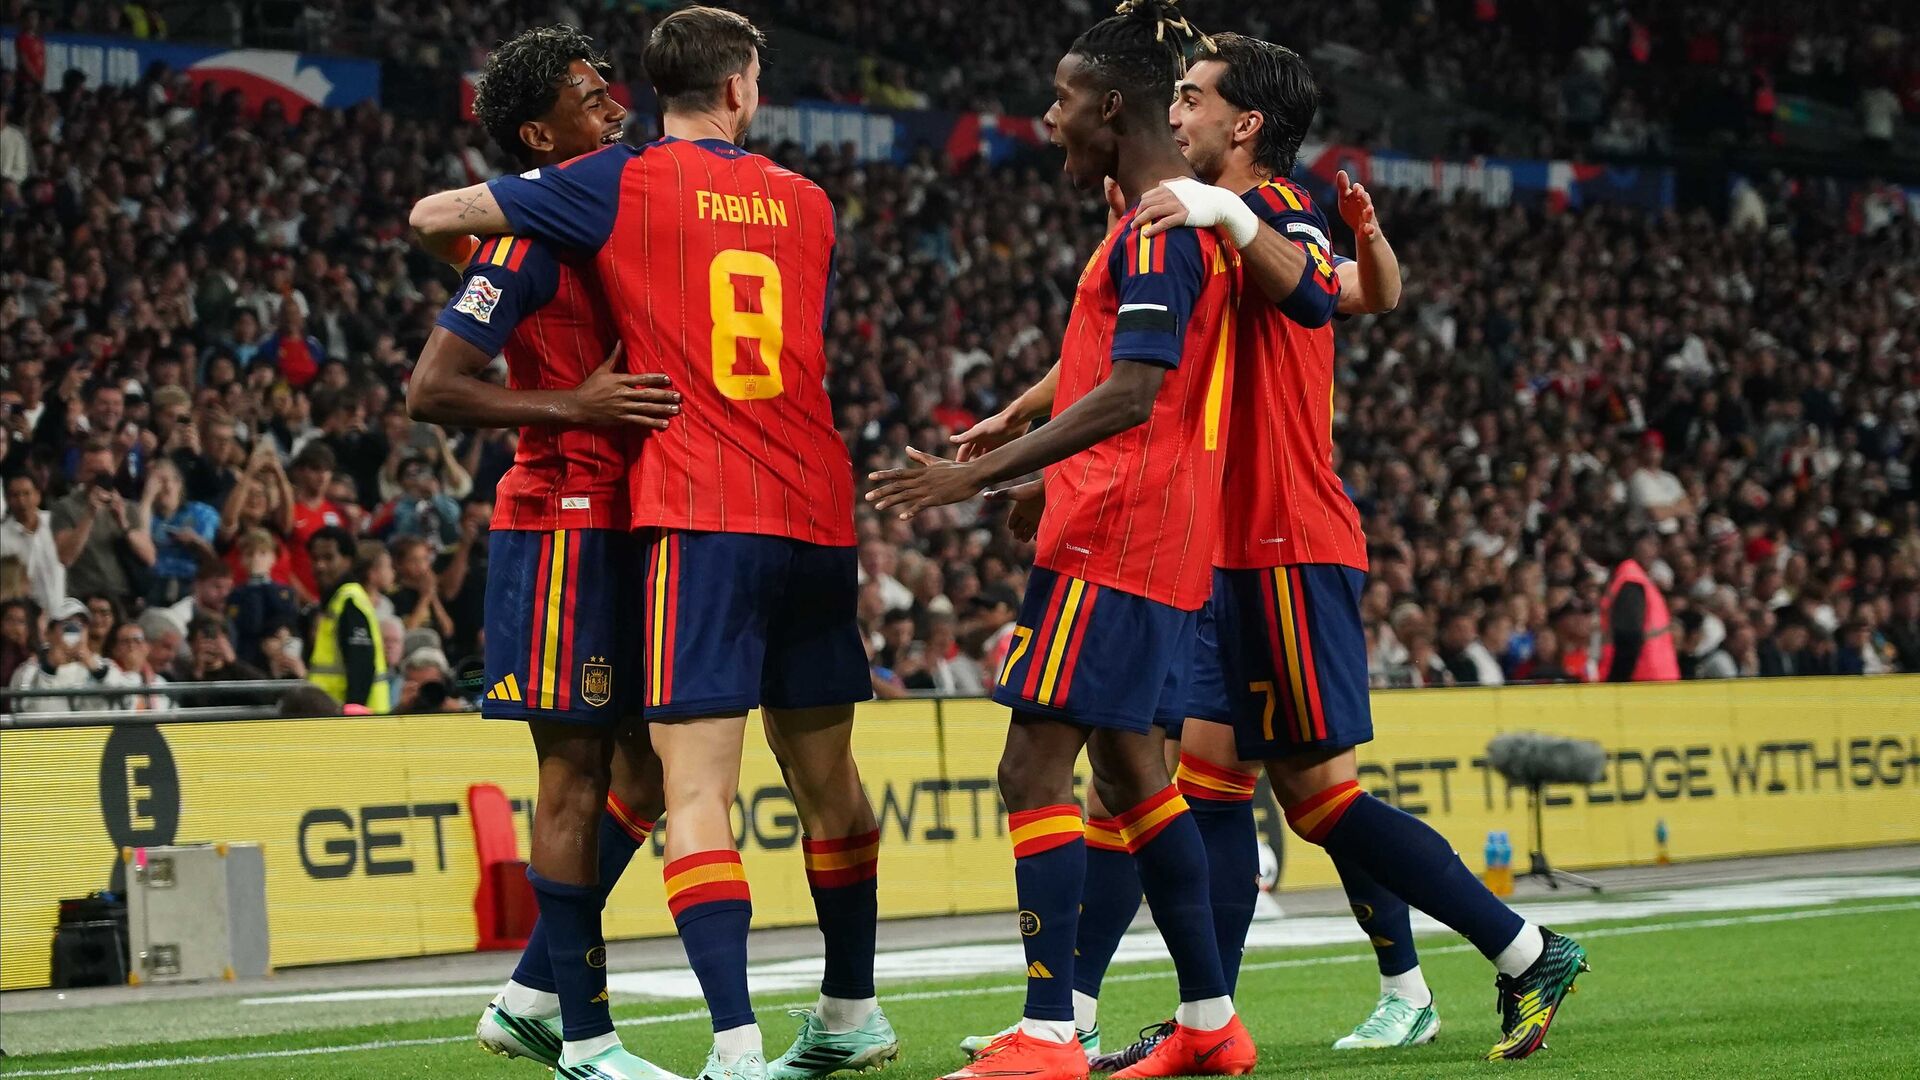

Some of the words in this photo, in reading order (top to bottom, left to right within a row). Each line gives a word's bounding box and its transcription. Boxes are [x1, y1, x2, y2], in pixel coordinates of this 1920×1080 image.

[696, 190, 788, 227] FABIÁN
[709, 249, 784, 400] 8
[1000, 625, 1034, 687] 7
[1249, 681, 1276, 741] 7
[124, 754, 157, 831] E
[1722, 740, 1847, 795] WITH
[298, 802, 459, 879] GET
